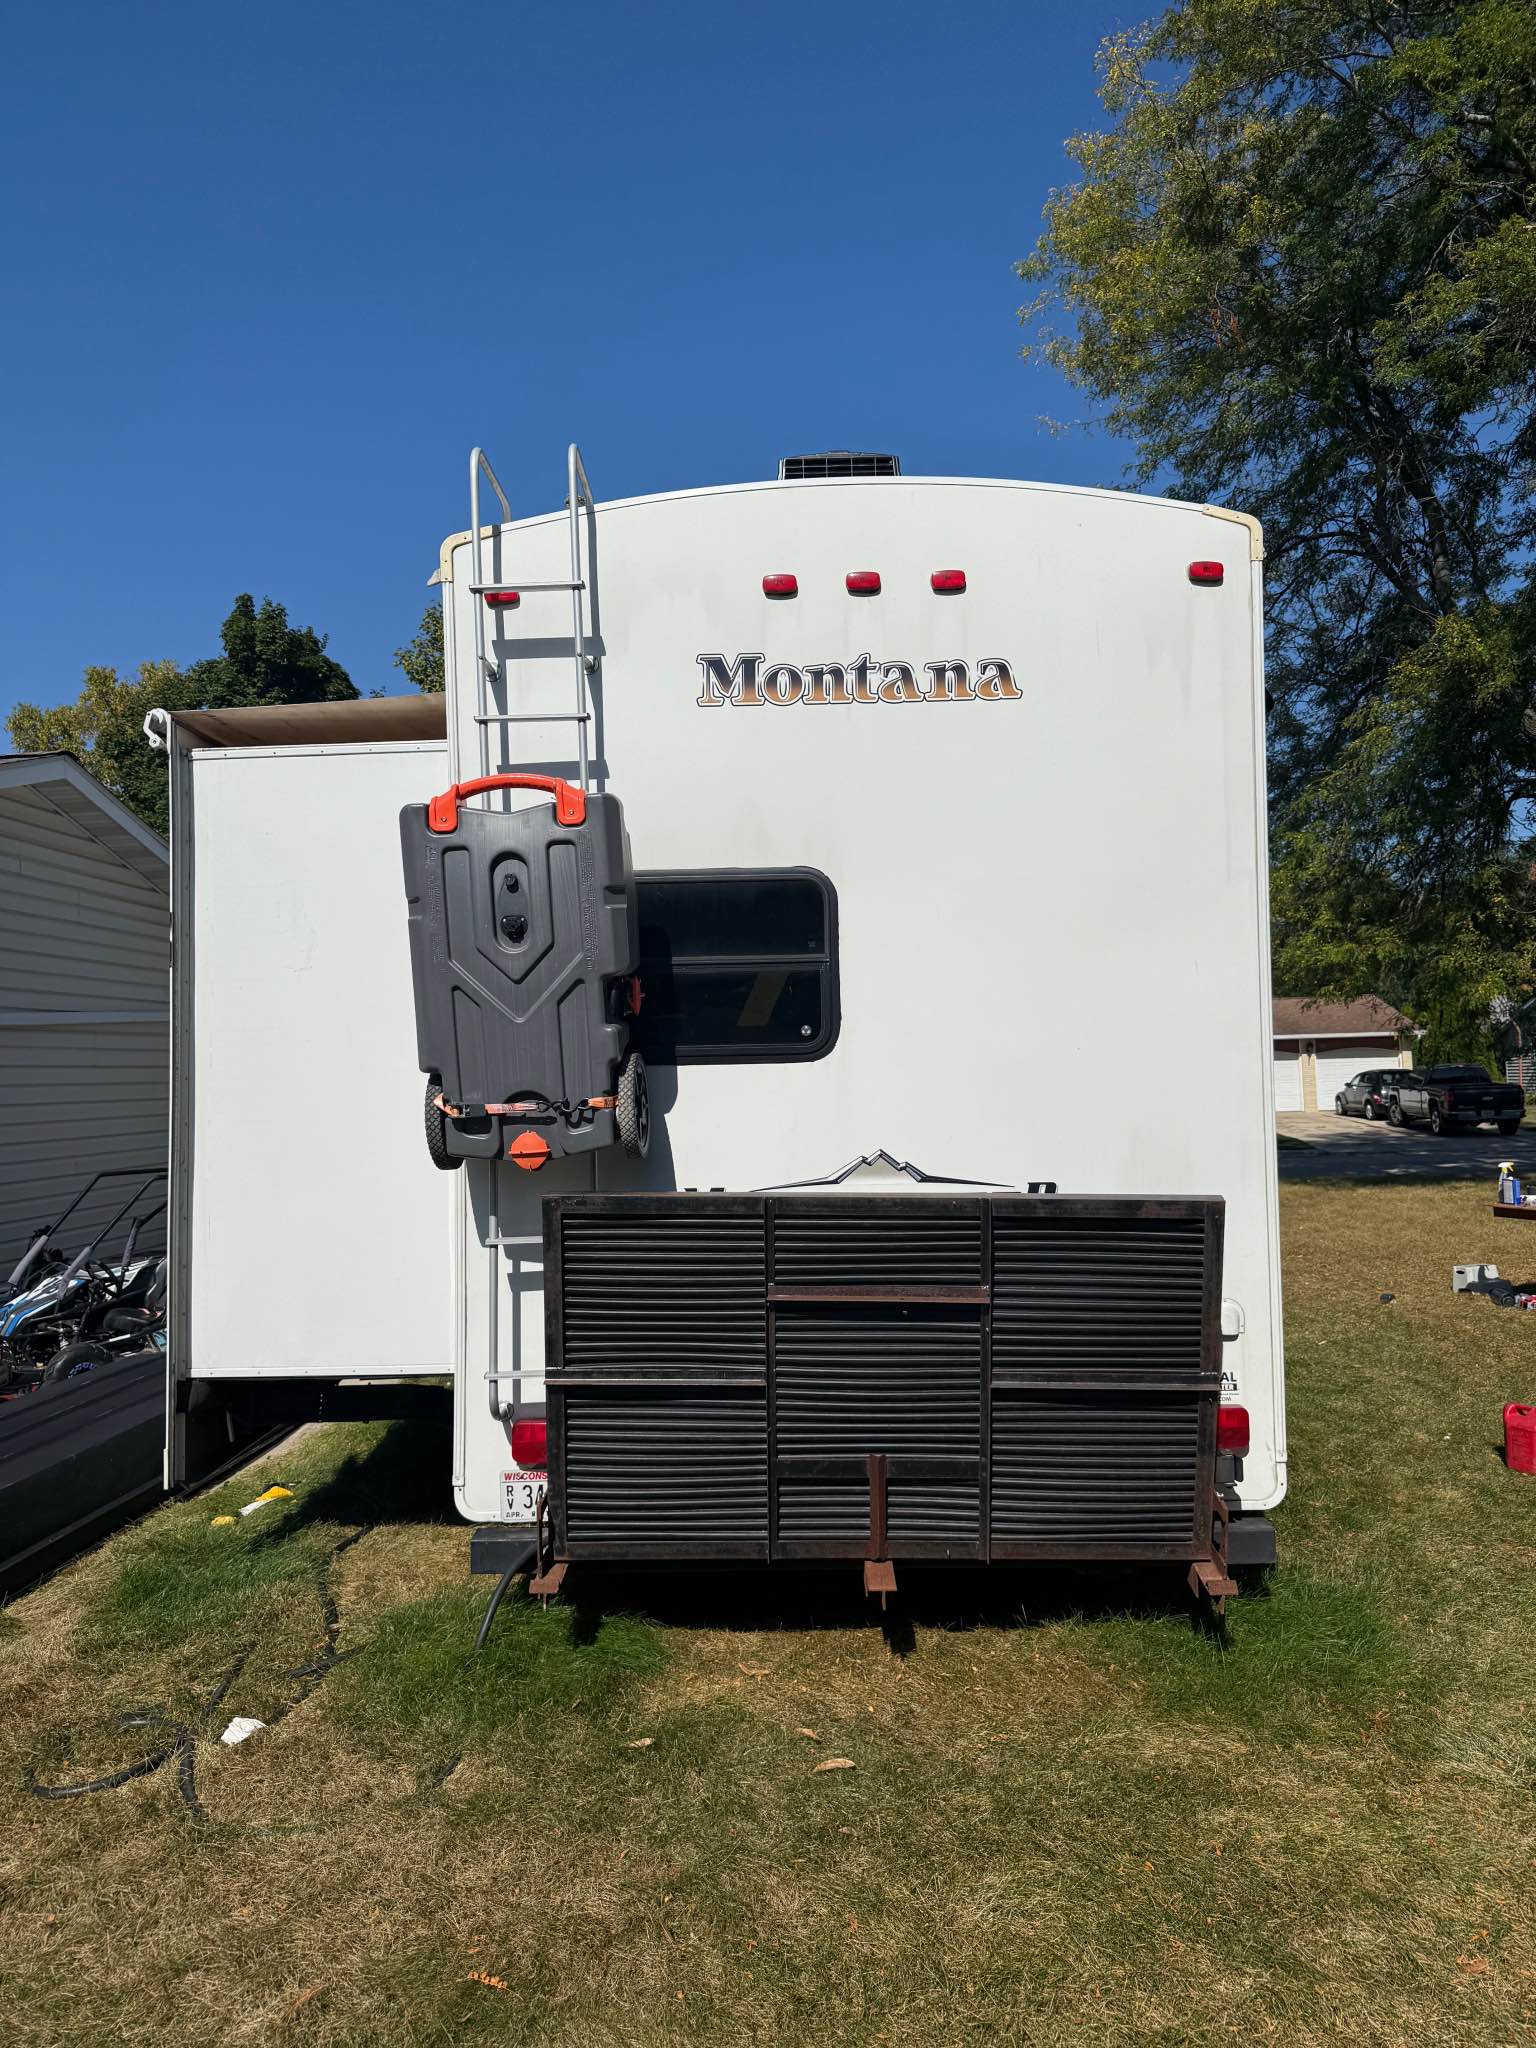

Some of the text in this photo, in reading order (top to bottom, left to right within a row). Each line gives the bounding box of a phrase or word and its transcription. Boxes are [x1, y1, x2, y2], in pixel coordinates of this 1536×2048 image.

[696, 652, 1023, 707] Montana
[1220, 1371, 1237, 1382] AL
[504, 1472, 547, 1481] WISCONS
